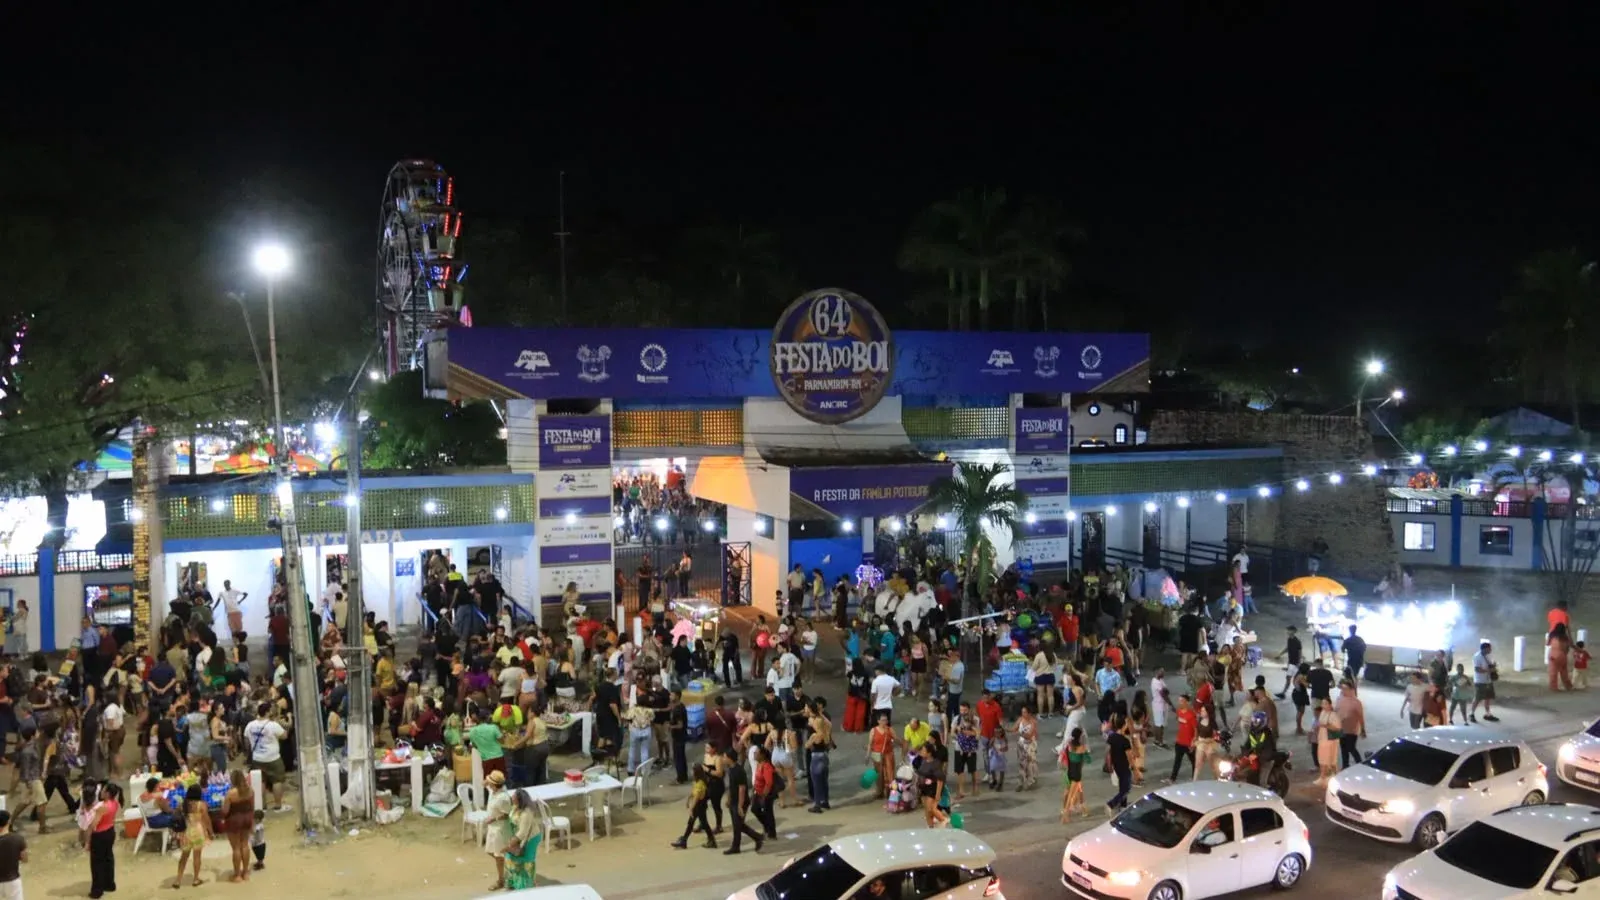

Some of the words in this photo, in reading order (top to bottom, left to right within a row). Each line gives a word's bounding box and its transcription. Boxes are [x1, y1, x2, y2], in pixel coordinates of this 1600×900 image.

[775, 341, 834, 374] FESTA
[832, 346, 852, 369] DO
[852, 341, 889, 373] BOI
[1021, 419, 1042, 433] FESTA
[1049, 418, 1063, 432] BOI
[544, 429, 574, 445] FESTA
[573, 430, 583, 442] DO
[583, 427, 602, 444] BOI
[814, 489, 821, 501] A
[822, 488, 848, 501] FESTA
[849, 488, 861, 501] DA
[862, 486, 892, 500] FAMÍLIA
[300, 529, 402, 547] ENTADA
